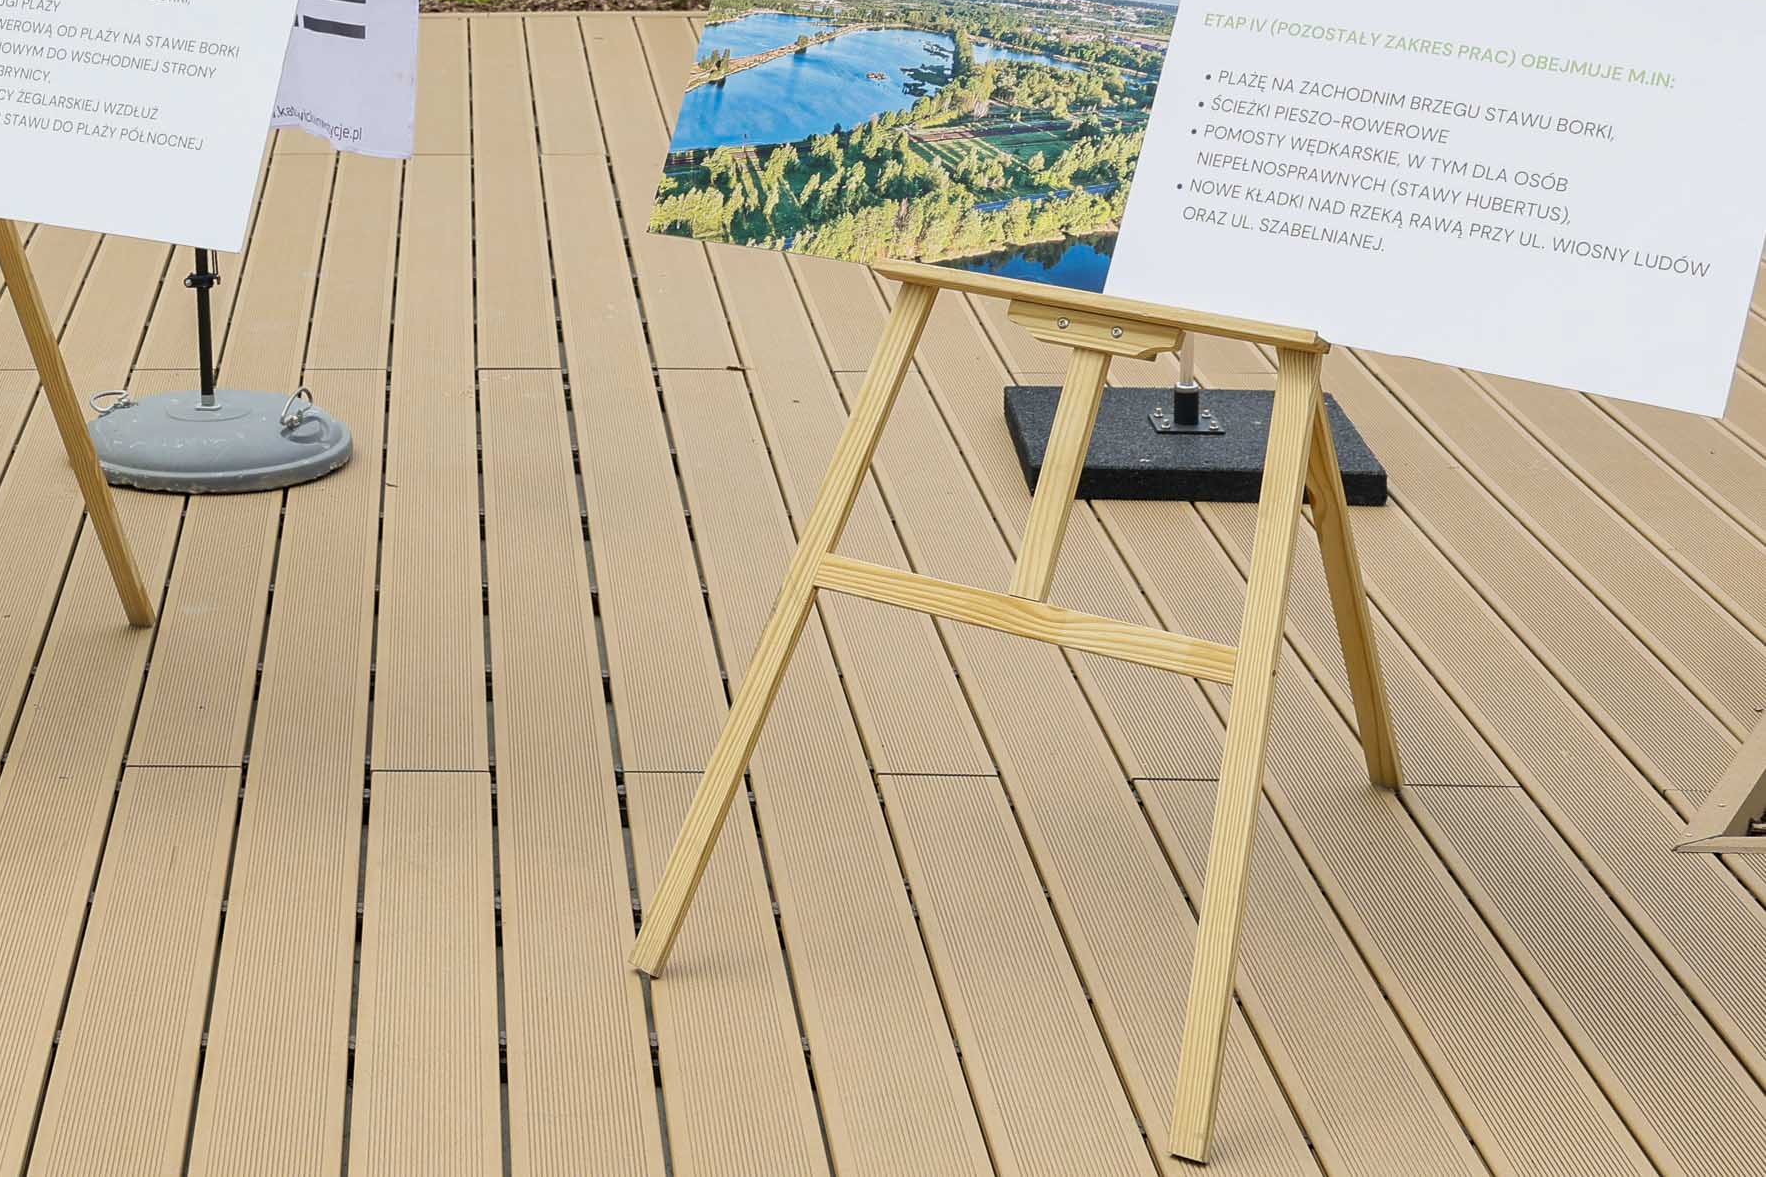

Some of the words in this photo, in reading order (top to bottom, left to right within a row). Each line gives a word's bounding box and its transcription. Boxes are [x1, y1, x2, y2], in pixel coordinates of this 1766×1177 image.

[45, 46, 67, 60] DO
[71, 49, 159, 72] WSCHODNIEJ
[161, 61, 216, 78] STRONY
[56, 24, 77, 37] OD
[79, 26, 120, 42] PLAŻY
[122, 32, 140, 46] NA
[145, 34, 196, 52] STAWIE
[198, 41, 240, 58] BORKI
[1203, 13, 1246, 29] ETAP
[1249, 17, 1268, 32] IV
[1270, 18, 1382, 46] (POZOSTAŁY
[1383, 34, 1453, 56] ZAKRES
[1457, 44, 1516, 68] PRAC)
[1520, 53, 1624, 81] OBEJMUJE
[15, 88, 99, 112] ŻEGLARSKIEJ
[103, 101, 158, 120] WZDŁUŻ
[1210, 93, 1270, 118] ŚCIEŻKI
[1274, 105, 1450, 144] PIESZO-ROWEROWE
[1217, 69, 1268, 92] PLAŻĘ
[1271, 77, 1294, 93] NA
[1298, 80, 1405, 108] ZACHODNIM
[1409, 95, 1480, 118] BRZEGU
[1484, 106, 1552, 129] STAWU
[2, 112, 50, 130] STAWU
[52, 118, 73, 132] DO
[76, 121, 117, 138] PLAŻY
[119, 126, 203, 150] PÓŁNOCNEJ
[1196, 150, 1386, 192] NIEPEŁNOSPRAWNYCH
[1390, 178, 1462, 204] (STAWY
[1203, 123, 1286, 148] POMOSTY
[1407, 153, 1426, 168] W
[1430, 157, 1468, 176] TYM
[1471, 163, 1507, 182] DLA
[1513, 170, 1568, 192] OSÓB
[1182, 205, 1228, 225] ORAZ
[1231, 213, 1253, 230] UL.
[1189, 178, 1242, 198] NOWE
[1244, 186, 1304, 208] KŁADKI
[1307, 196, 1345, 214] NAD
[1349, 202, 1402, 229] RZEKĄ
[1408, 212, 1462, 238] RAWĄ
[1468, 222, 1514, 243] PRZY
[1519, 230, 1545, 249] UL.
[1552, 236, 1630, 262] WIOSNY
[1633, 250, 1710, 277] LUDÓW
